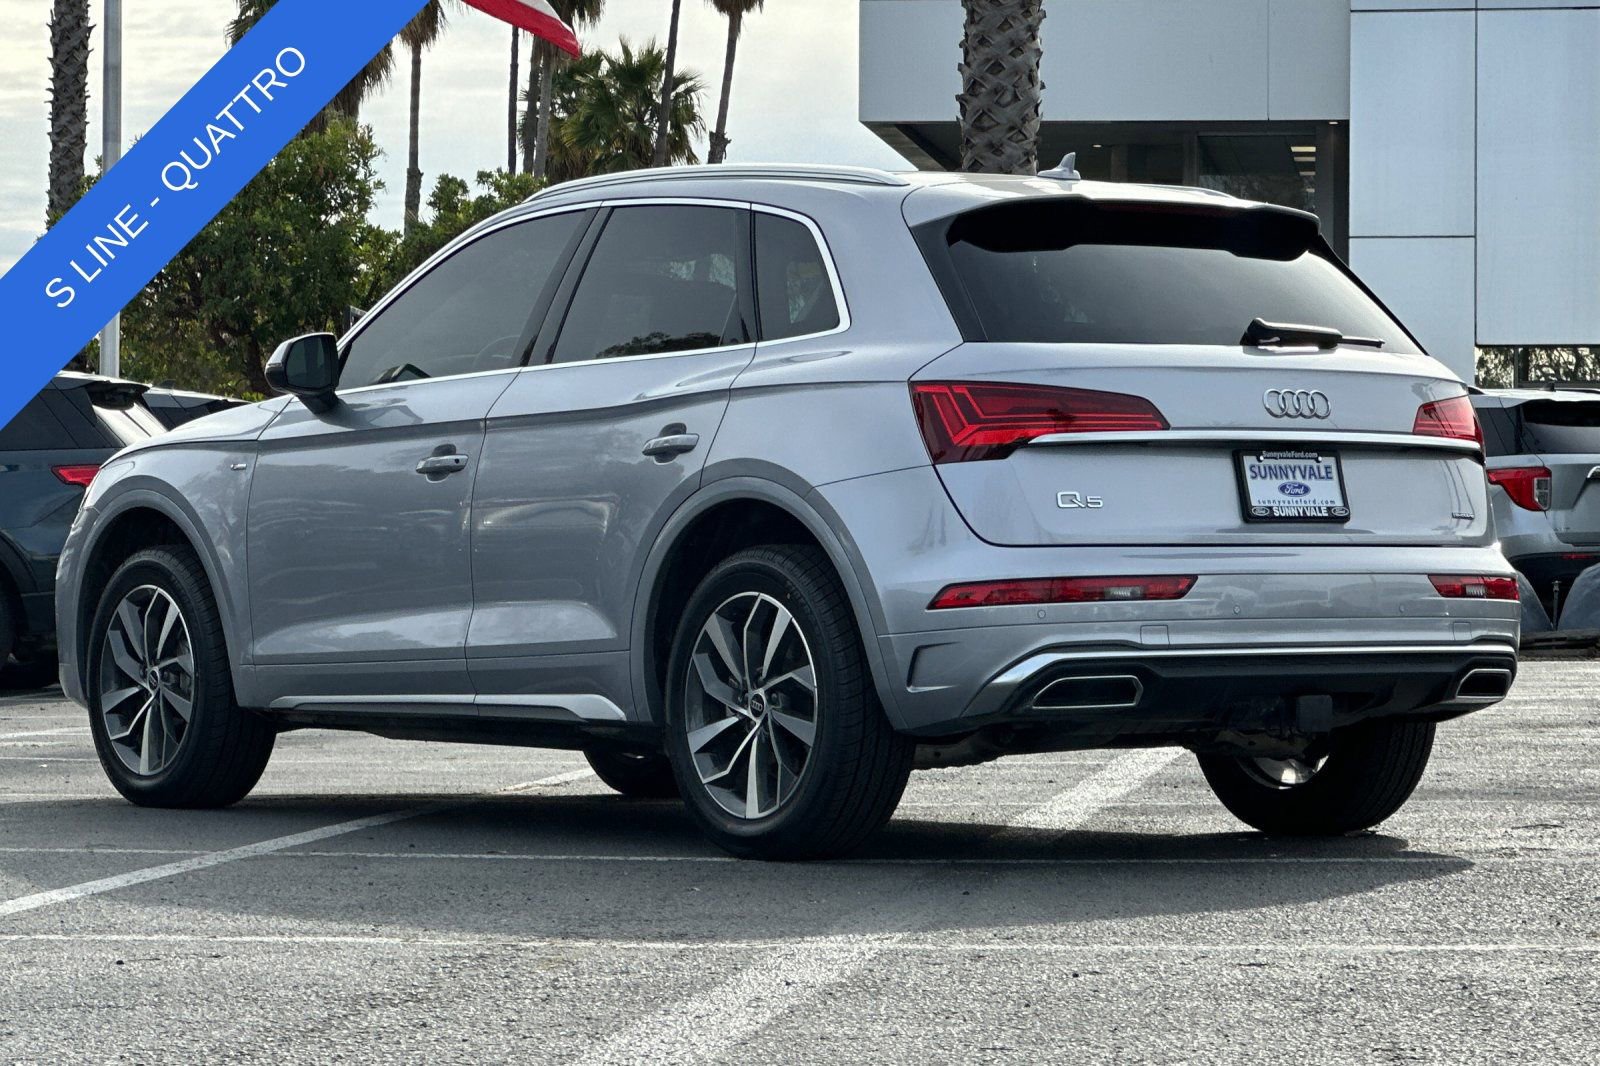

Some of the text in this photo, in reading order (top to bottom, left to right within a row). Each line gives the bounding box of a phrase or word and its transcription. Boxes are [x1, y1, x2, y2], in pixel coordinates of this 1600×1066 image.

[1262, 450, 1318, 459] SunnyvaleFord.com
[1249, 464, 1333, 480] SUNNYVALE
[1284, 483, 1306, 496] Ford
[1057, 491, 1104, 508] Q5
[1273, 507, 1328, 516] SUNNYVALE
